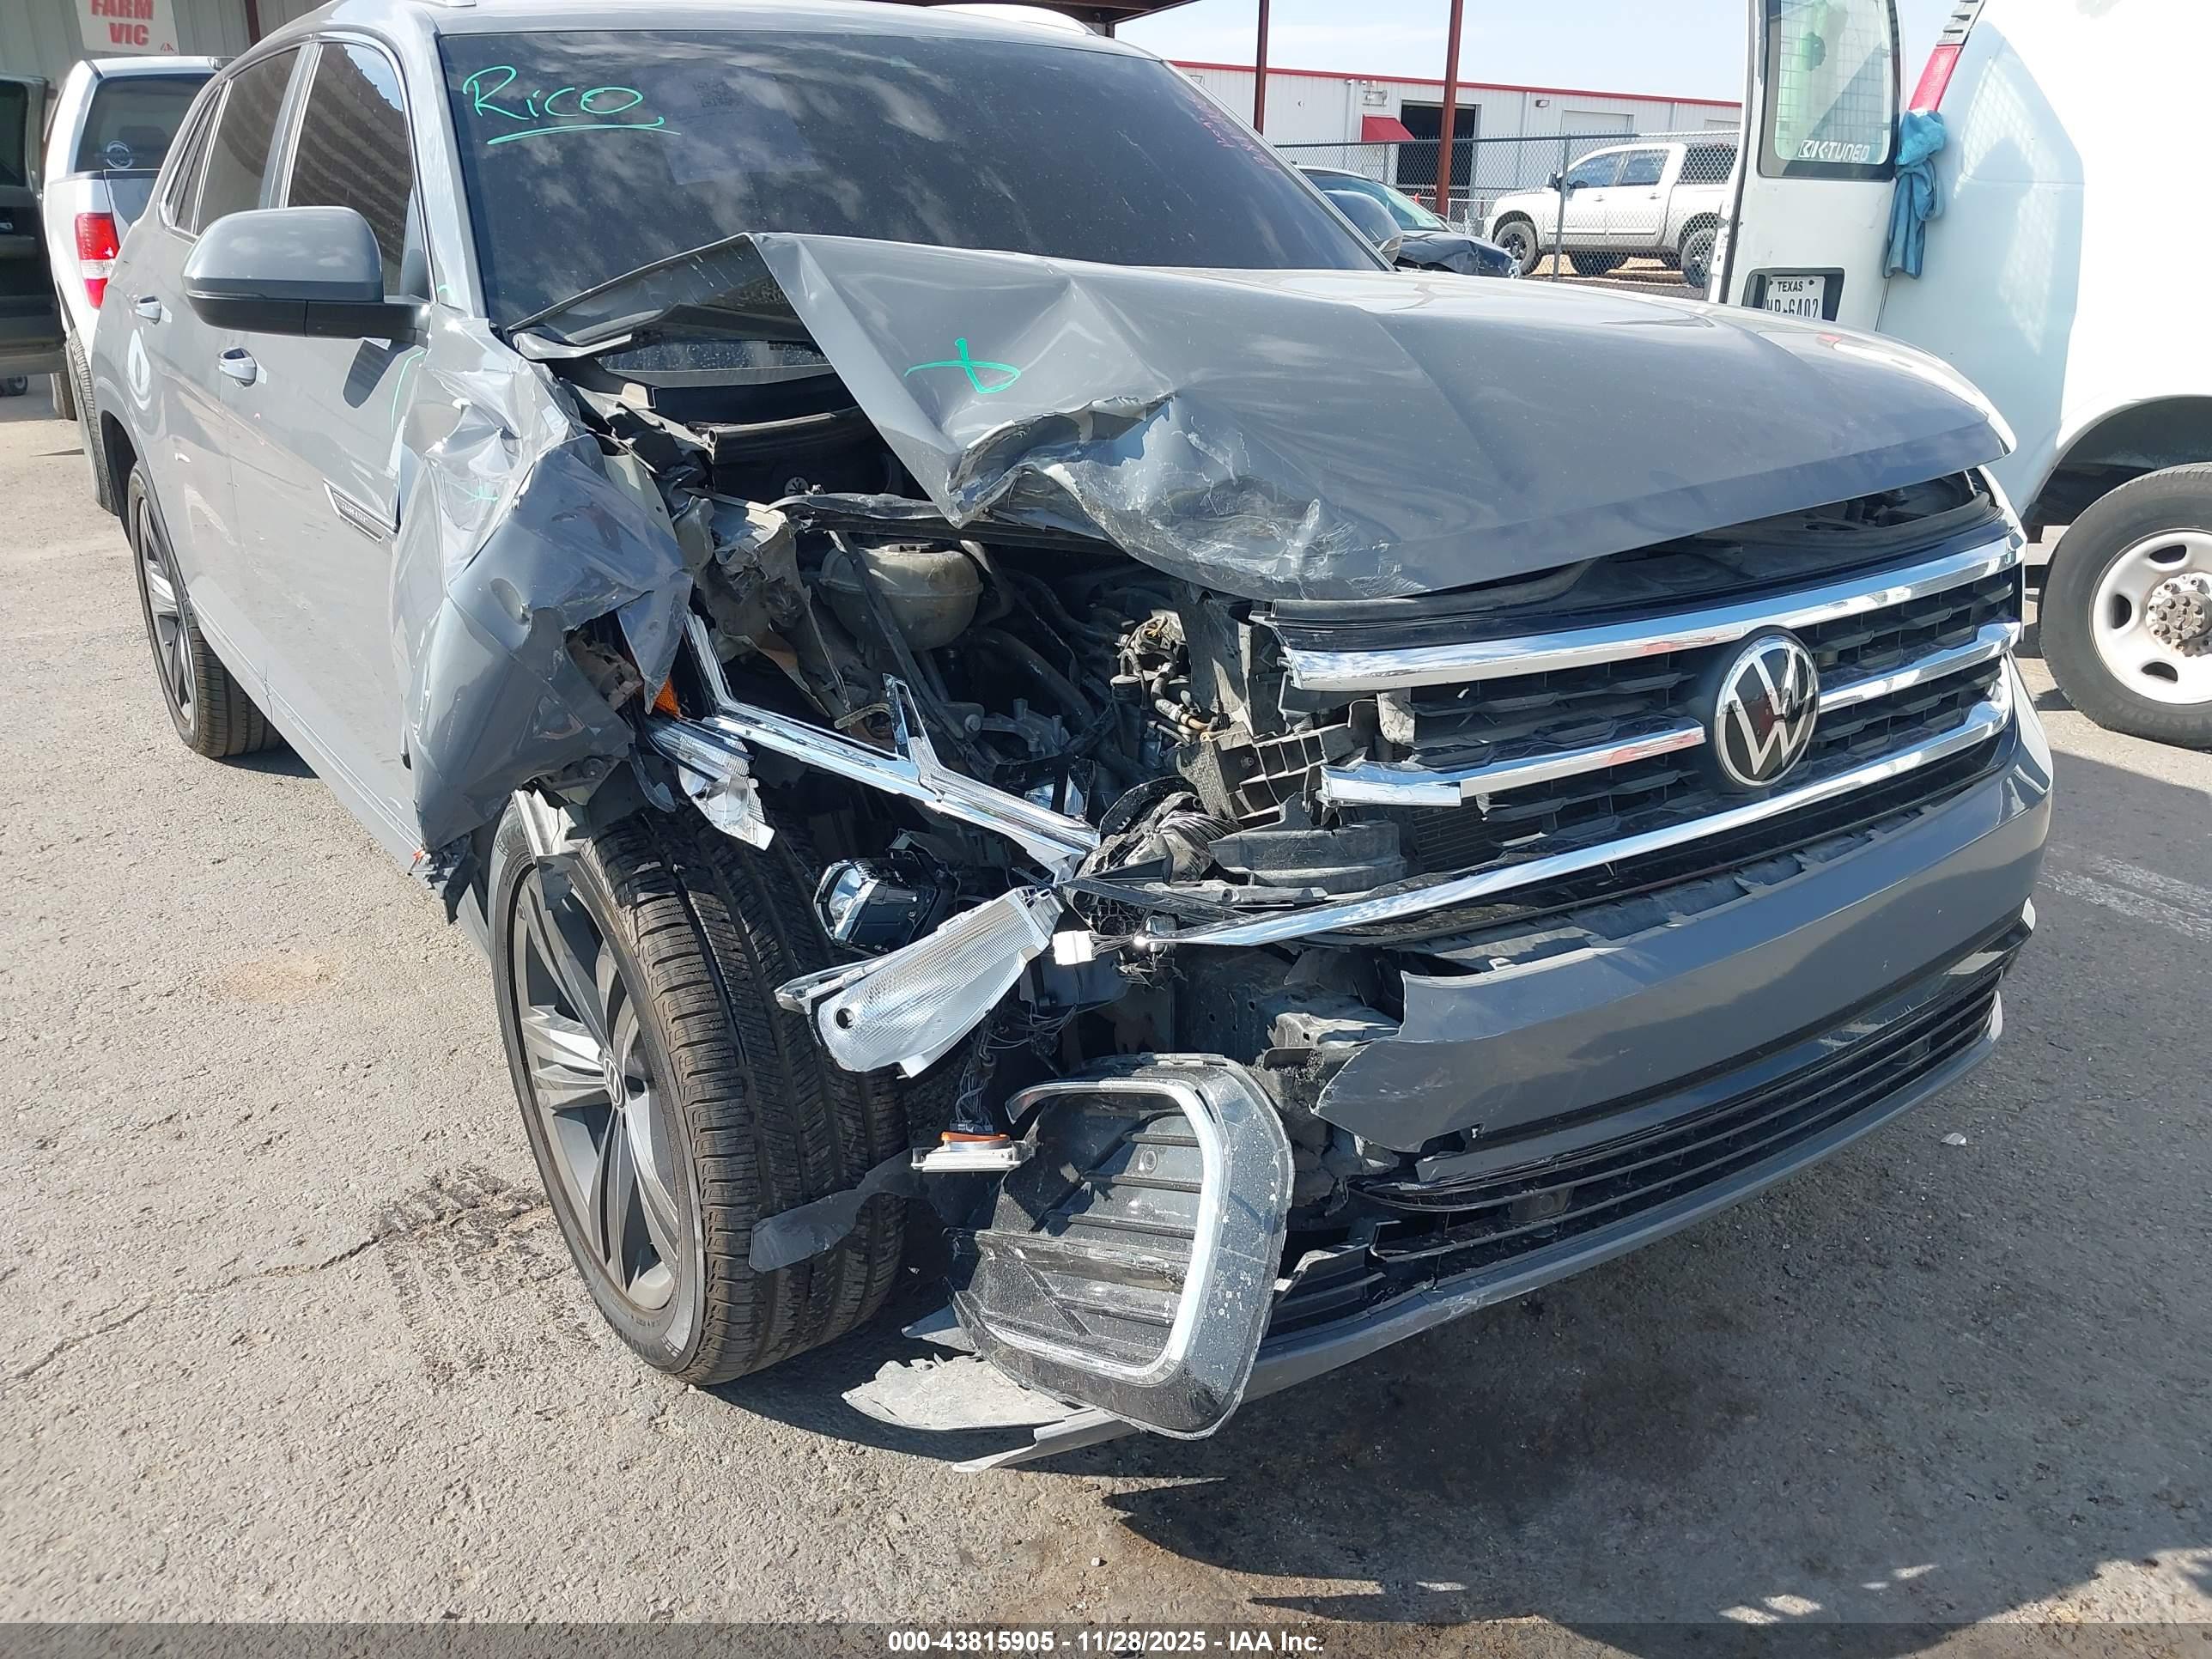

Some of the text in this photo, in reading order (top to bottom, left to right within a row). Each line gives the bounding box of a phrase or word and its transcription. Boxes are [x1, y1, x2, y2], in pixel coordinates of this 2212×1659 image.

[90, 0, 154, 20] FARM
[109, 22, 149, 46] VIC
[1778, 281, 1803, 292] TEXAS
